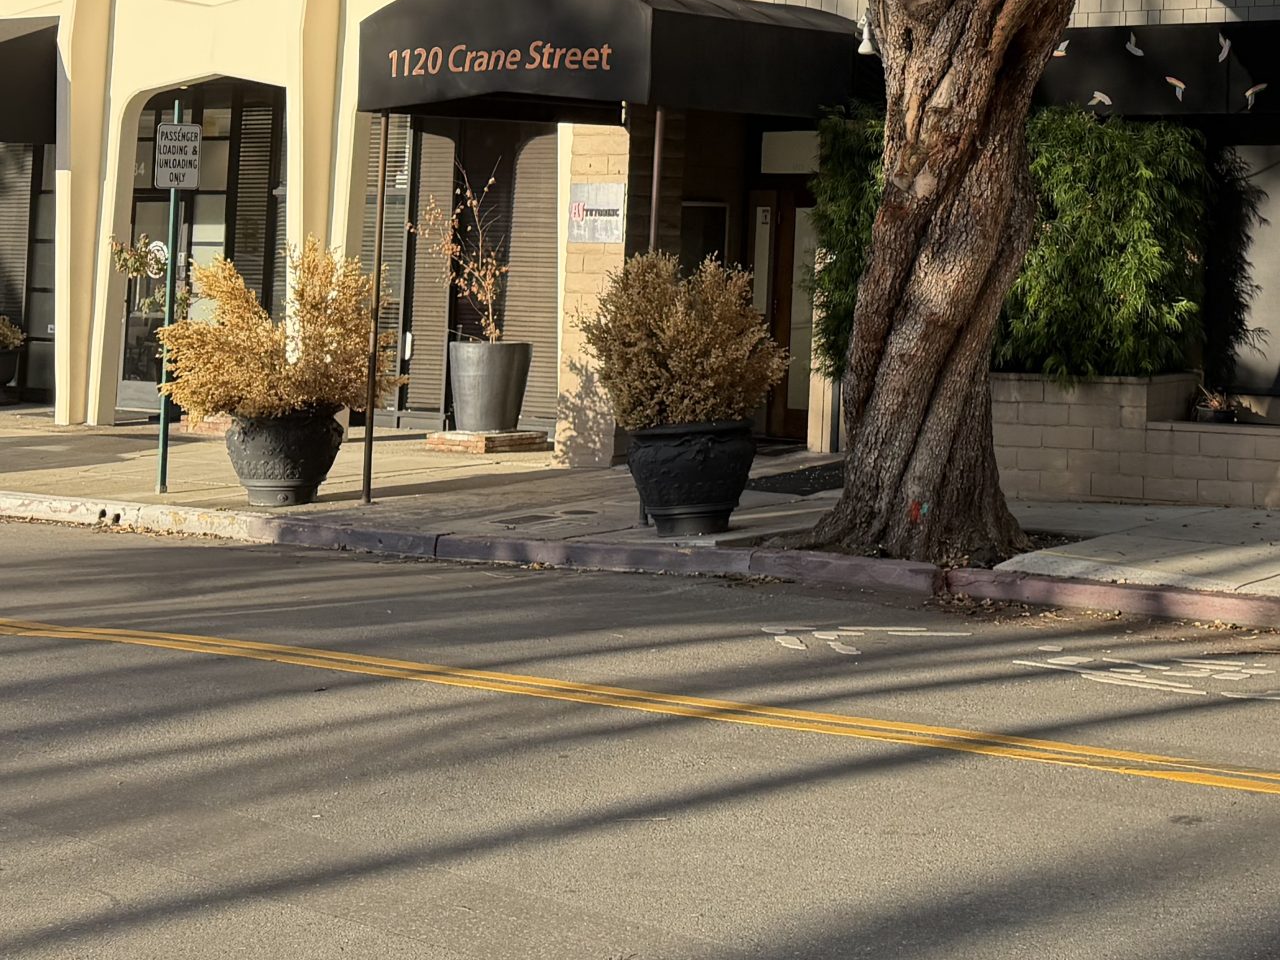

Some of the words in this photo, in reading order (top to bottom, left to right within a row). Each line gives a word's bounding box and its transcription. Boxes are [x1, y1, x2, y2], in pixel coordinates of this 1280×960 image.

[388, 46, 443, 78] 1120
[448, 44, 522, 73] Crane
[525, 40, 612, 70] Street
[161, 131, 198, 141] PASSENGER
[160, 145, 187, 155] LOADING
[192, 145, 198, 155] &
[160, 159, 197, 169] UNLOADING
[169, 172, 186, 182] ONLY
